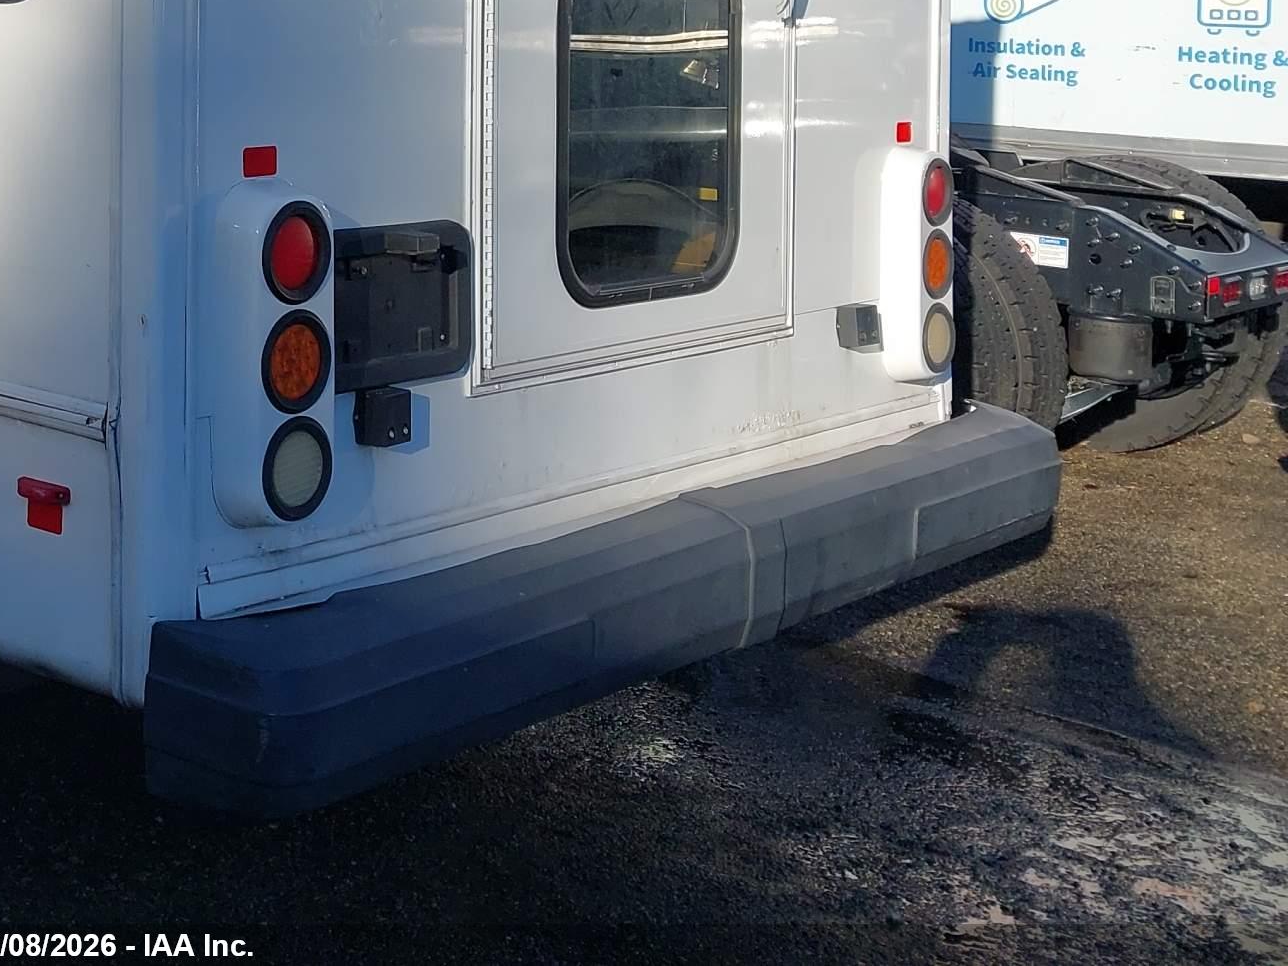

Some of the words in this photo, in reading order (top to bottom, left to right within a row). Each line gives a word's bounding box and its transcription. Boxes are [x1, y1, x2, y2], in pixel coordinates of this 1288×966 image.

[968, 37, 1066, 58] Insulation
[1070, 41, 1086, 58] &
[1178, 46, 1267, 70] Heating
[1273, 50, 1288, 67] &
[973, 62, 999, 79] Air
[1006, 64, 1078, 87] Sealing
[1189, 74, 1277, 98] Cooling
